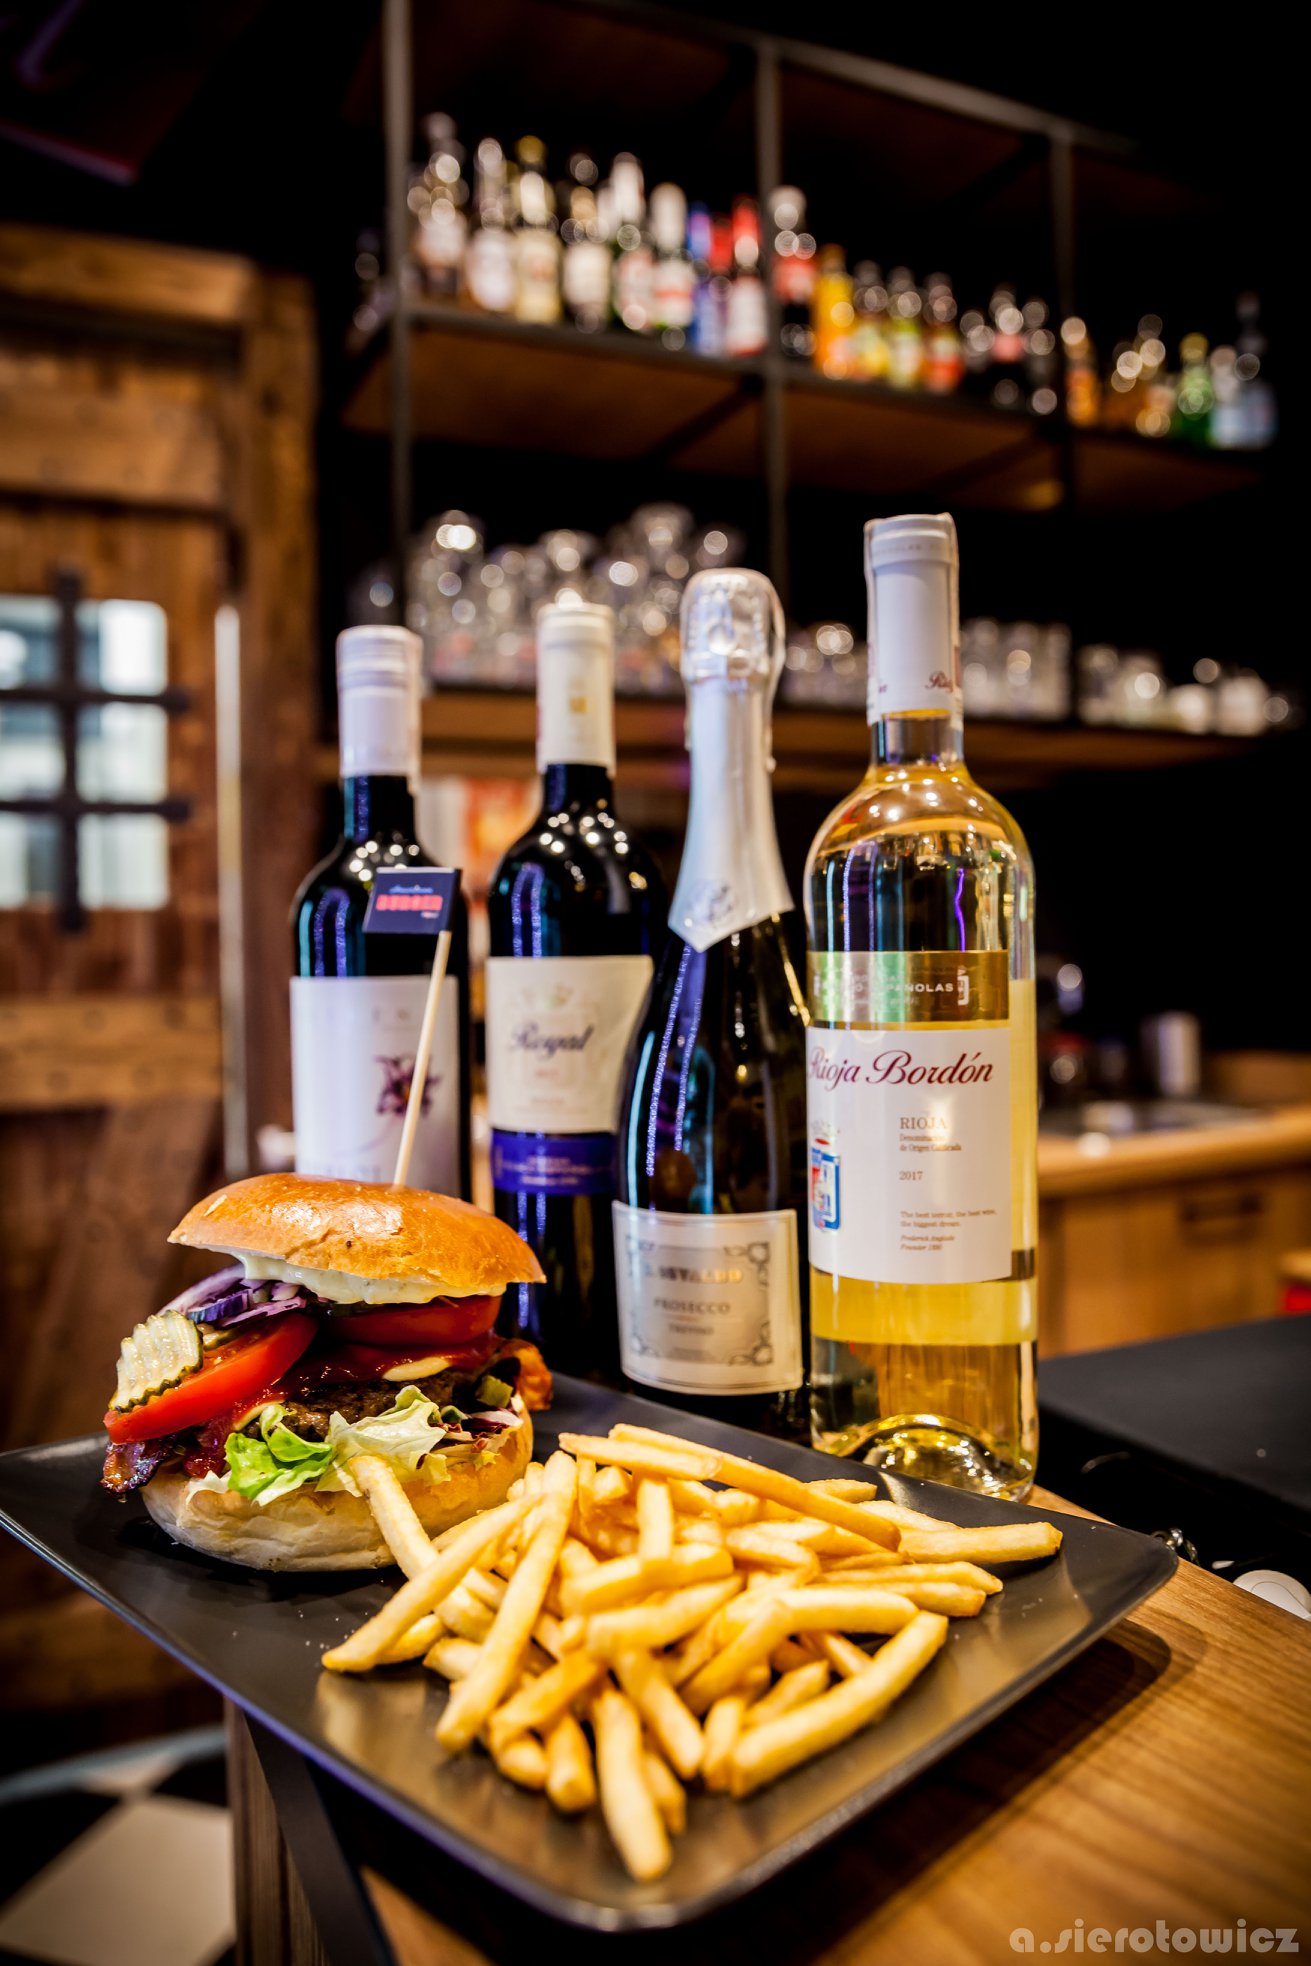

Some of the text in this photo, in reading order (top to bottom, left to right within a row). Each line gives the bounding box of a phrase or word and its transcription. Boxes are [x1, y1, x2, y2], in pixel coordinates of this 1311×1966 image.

[808, 1047, 994, 1092] Rioja Bordón
[900, 1117, 948, 1130] RIOJA
[899, 1170, 924, 1181] 2017
[653, 1297, 732, 1316] PROSECCO
